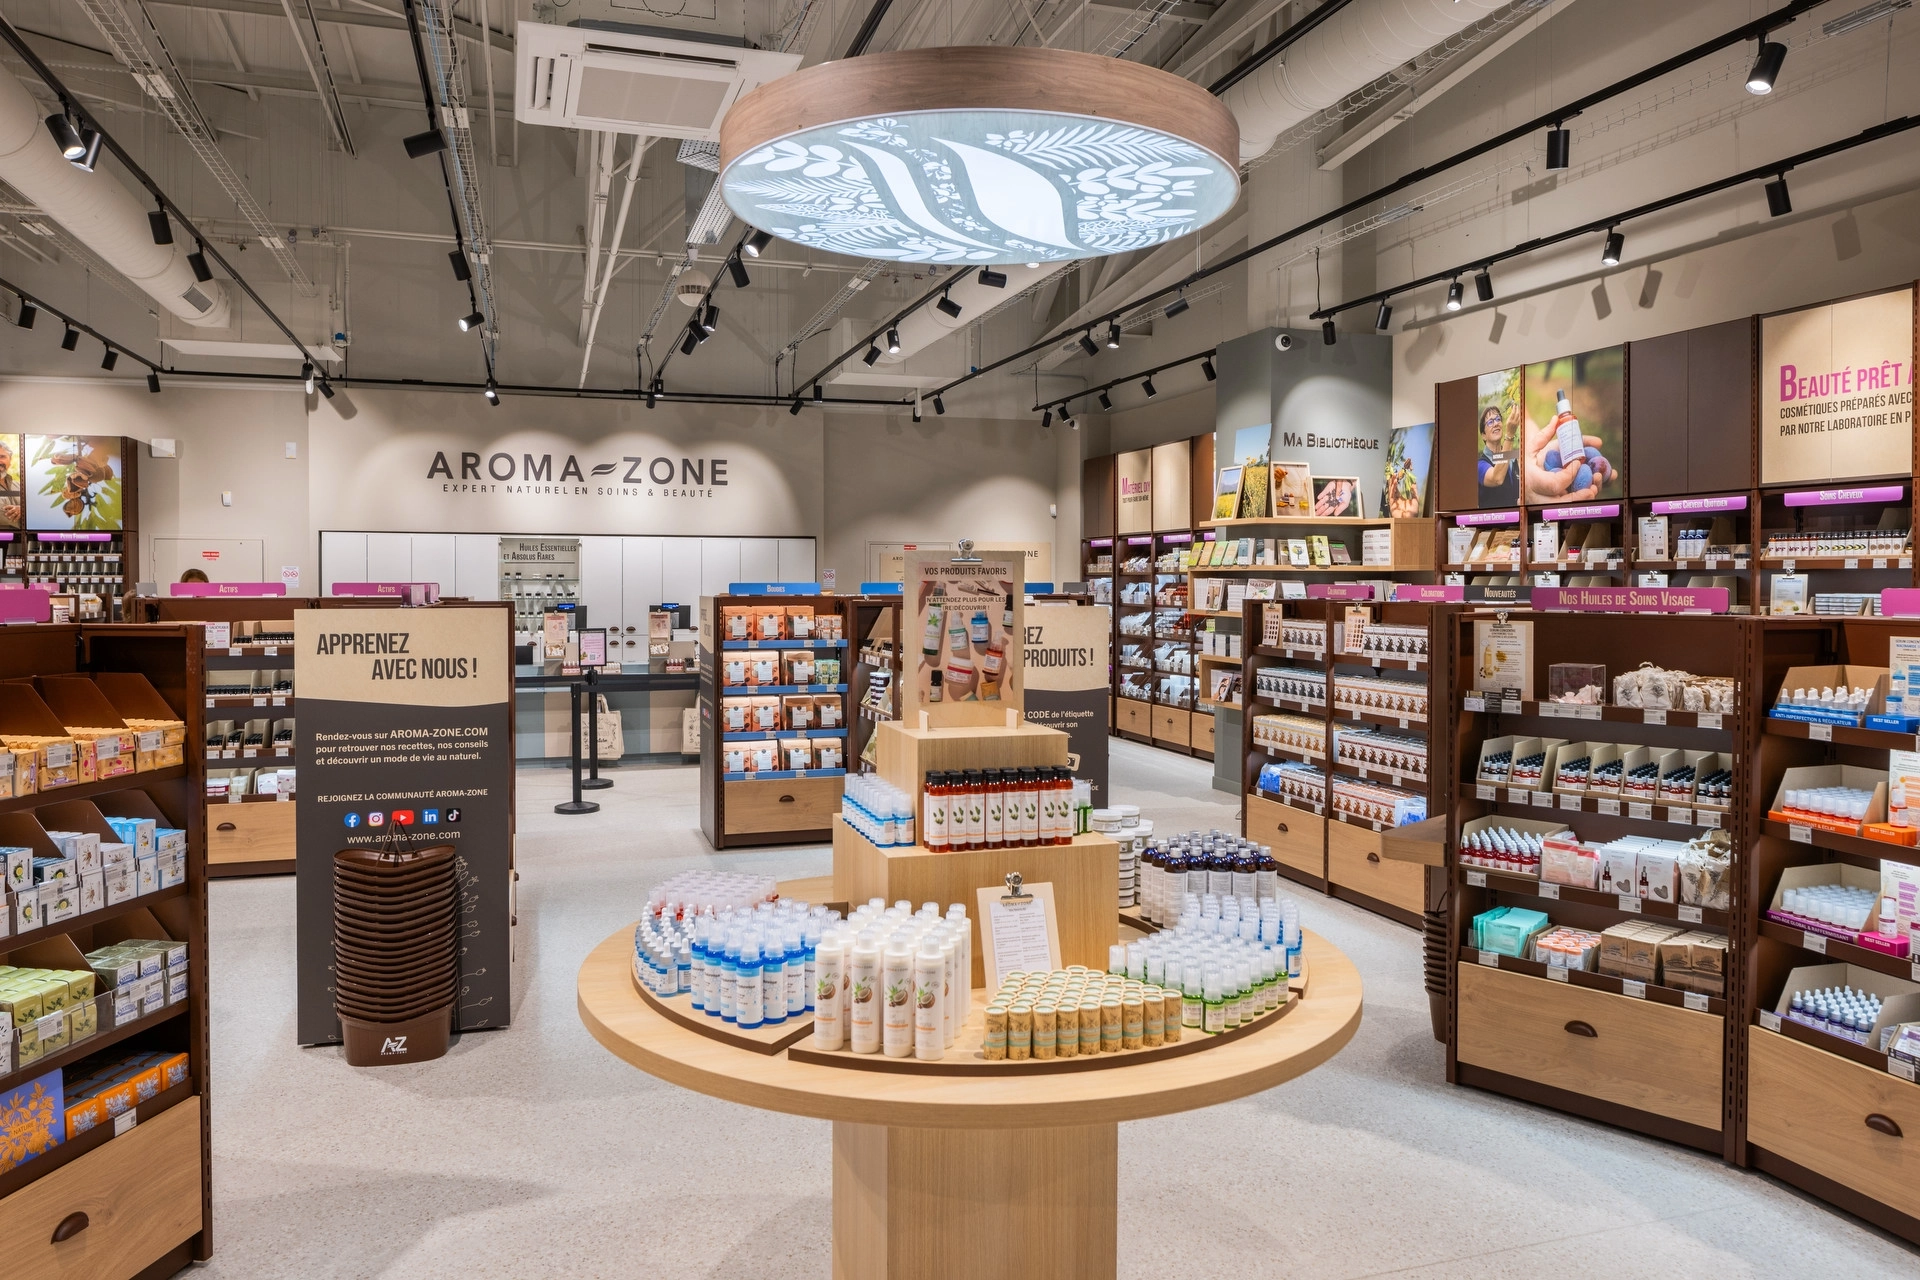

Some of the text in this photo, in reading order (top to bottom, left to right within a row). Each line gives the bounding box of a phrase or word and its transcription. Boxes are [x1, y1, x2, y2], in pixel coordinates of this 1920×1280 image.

[1780, 364, 1852, 402] BEAUTÉ
[1857, 360, 1903, 391] PRÊT
[1780, 401, 1839, 419] COSMÉTIQUES
[1840, 393, 1886, 412] PRÉPARÉS
[1780, 424, 1797, 437] PAR
[1798, 420, 1826, 434] NOTRE
[1827, 413, 1889, 431] LABORATOIRE
[1890, 411, 1903, 425] EN
[1283, 432, 1380, 450] MA BIBLIOTHÈQUE
[426, 451, 728, 486] AROMA ZONE
[443, 484, 714, 498] EXPERT NATUREL EN SOINS & BEAUTÉ
[1819, 489, 1864, 501] SOINS CHEVEUX
[519, 543, 577, 552] HUILES ESSENTIELLES
[511, 551, 535, 561] ABSOLUS
[536, 552, 555, 561] RARES
[924, 567, 1007, 576] VOS PRODUITS FAVORIS
[219, 584, 239, 593] ACTIFS
[377, 585, 396, 593] ACTIFS
[1484, 587, 1517, 598] NOUVEAUTÉS
[1558, 591, 1695, 607] NOS HUILES DE SOINS VISAGE
[316, 633, 410, 655] APPRENEZ
[371, 657, 478, 680] AVEC NOUS !
[1027, 710, 1050, 719] CODE
[1060, 709, 1094, 719] l'étiquette
[316, 727, 489, 741] Rendez-vous sur AROMA-ZONE.COM
[316, 744, 337, 754] pour
[338, 742, 379, 752] retrouver
[380, 743, 396, 751] nos
[398, 741, 436, 751] recettes,
[454, 739, 489, 749] conseils
[316, 757, 325, 765] et
[327, 755, 369, 765] découvrir
[383, 754, 408, 763] mode
[410, 753, 421, 762] de
[422, 753, 435, 762] vie
[449, 751, 482, 761] naturel.
[317, 794, 363, 803] REJOIGNEZ
[376, 790, 435, 801] COMMUNAUTÉ
[436, 788, 488, 798] AROMA-ZONE
